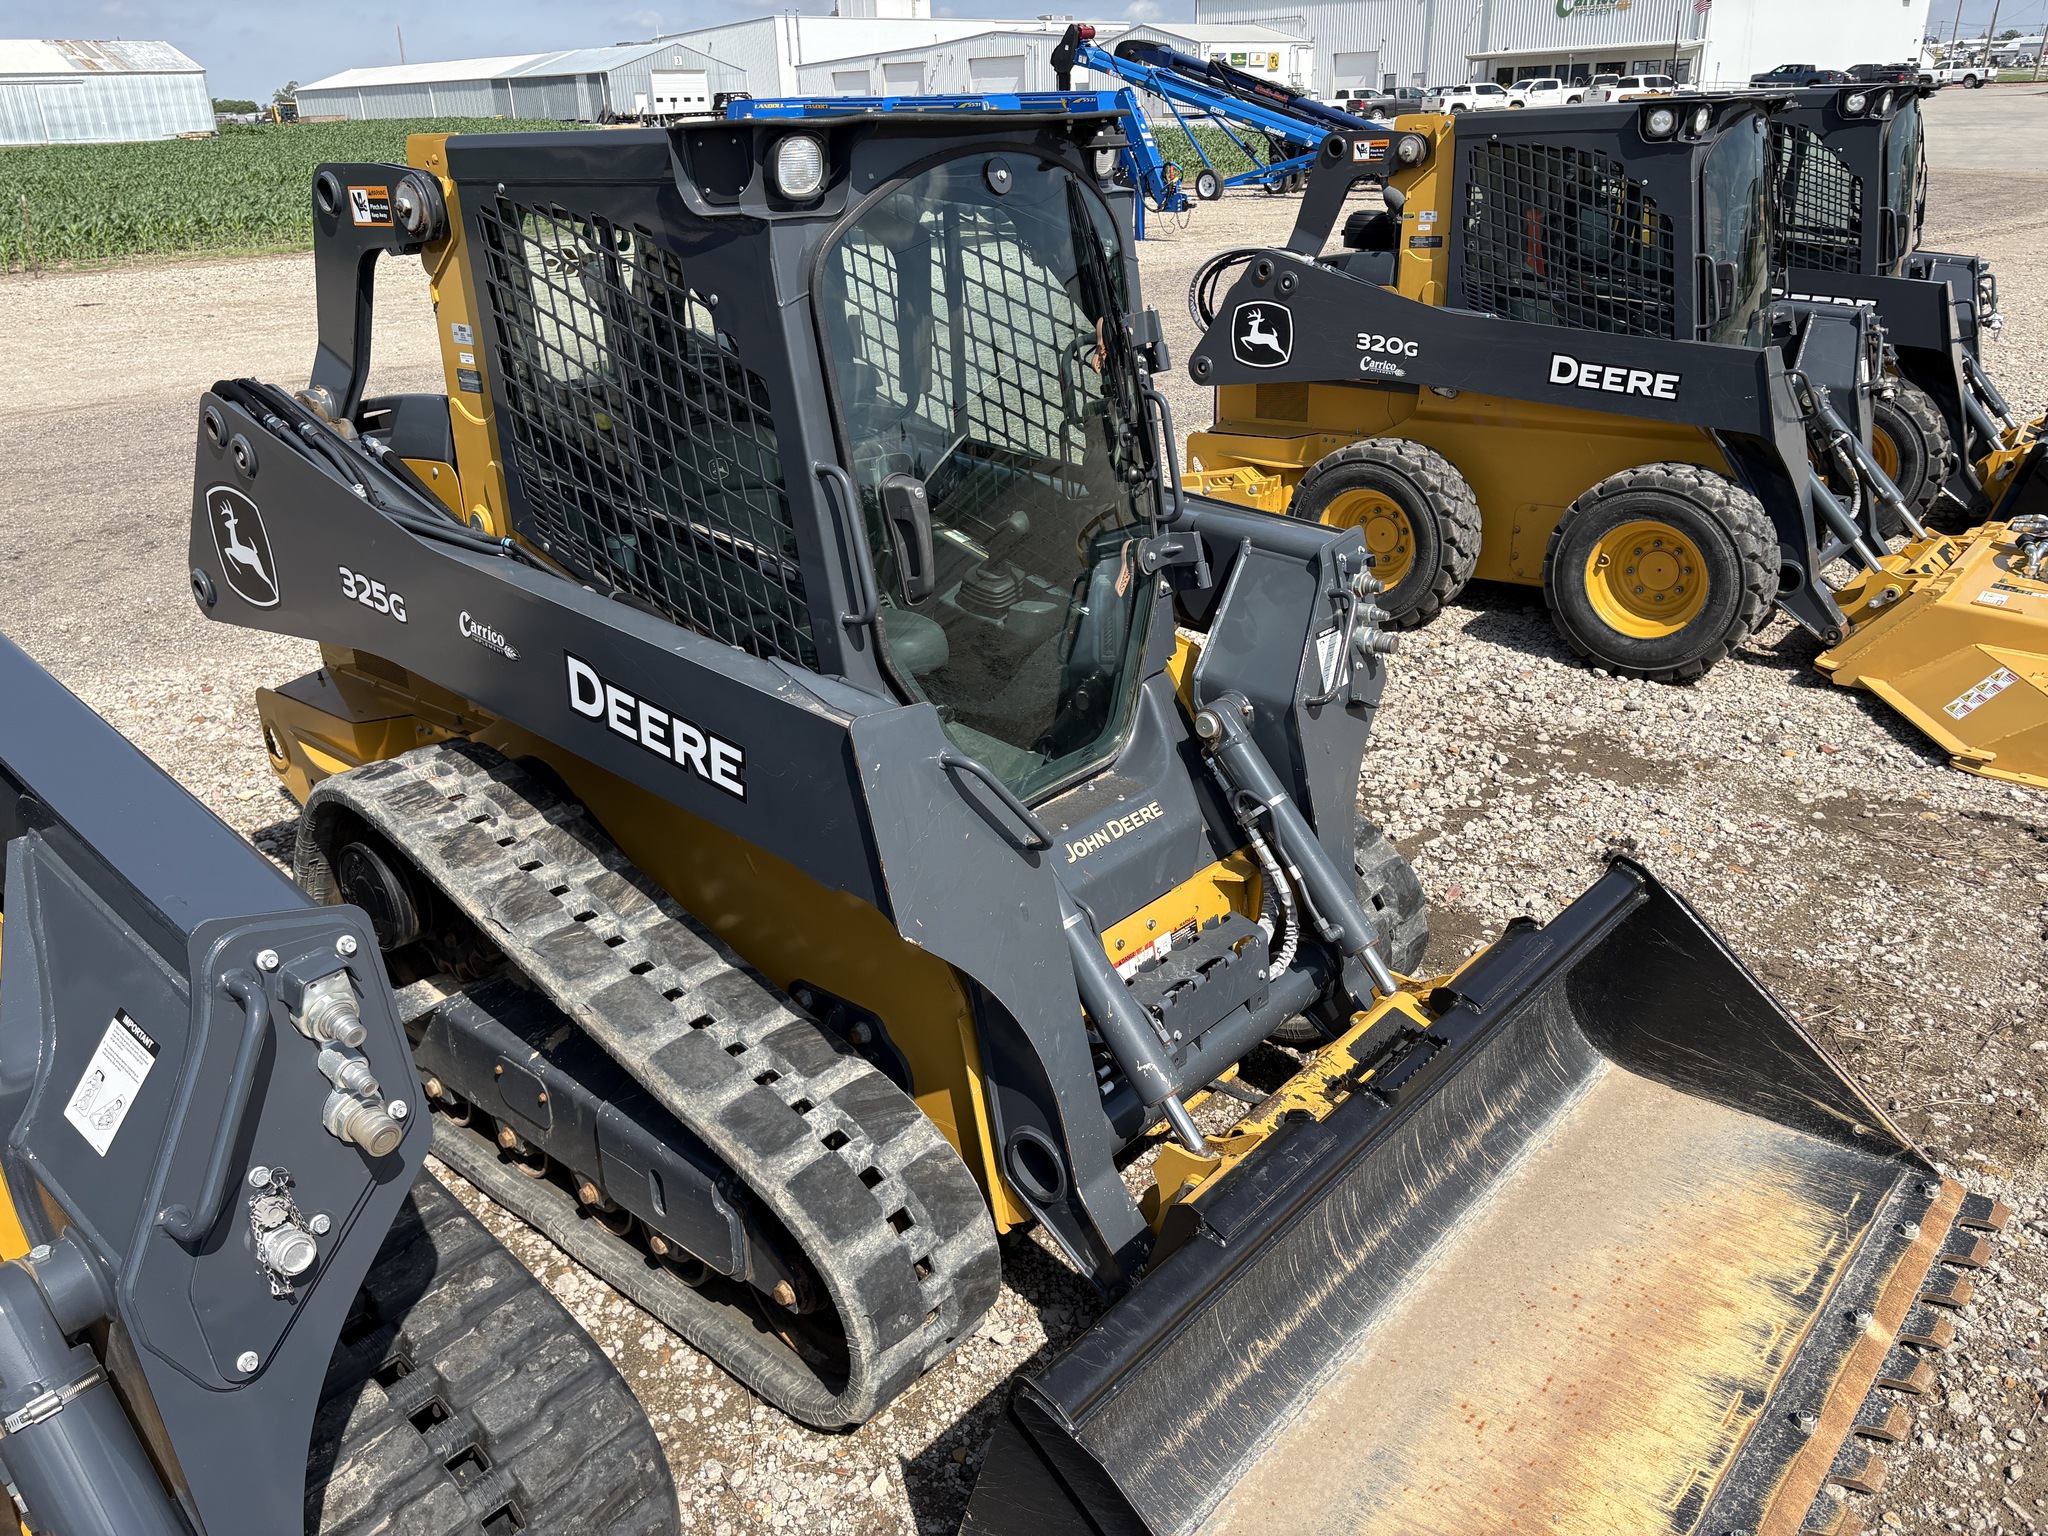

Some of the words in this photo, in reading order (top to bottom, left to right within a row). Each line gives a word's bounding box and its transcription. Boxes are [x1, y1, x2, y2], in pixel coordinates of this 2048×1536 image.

[1356, 332, 1419, 357] 320G
[1360, 355, 1397, 371] Carrico
[1549, 354, 1680, 400] DEERE
[338, 566, 407, 623] 325G
[459, 611, 505, 648] Carrico
[567, 655, 745, 797] DEERE
[1064, 829, 1112, 864] JOHN
[1105, 801, 1164, 840] DEERE
[122, 1014, 155, 1049] IMPORTANT
